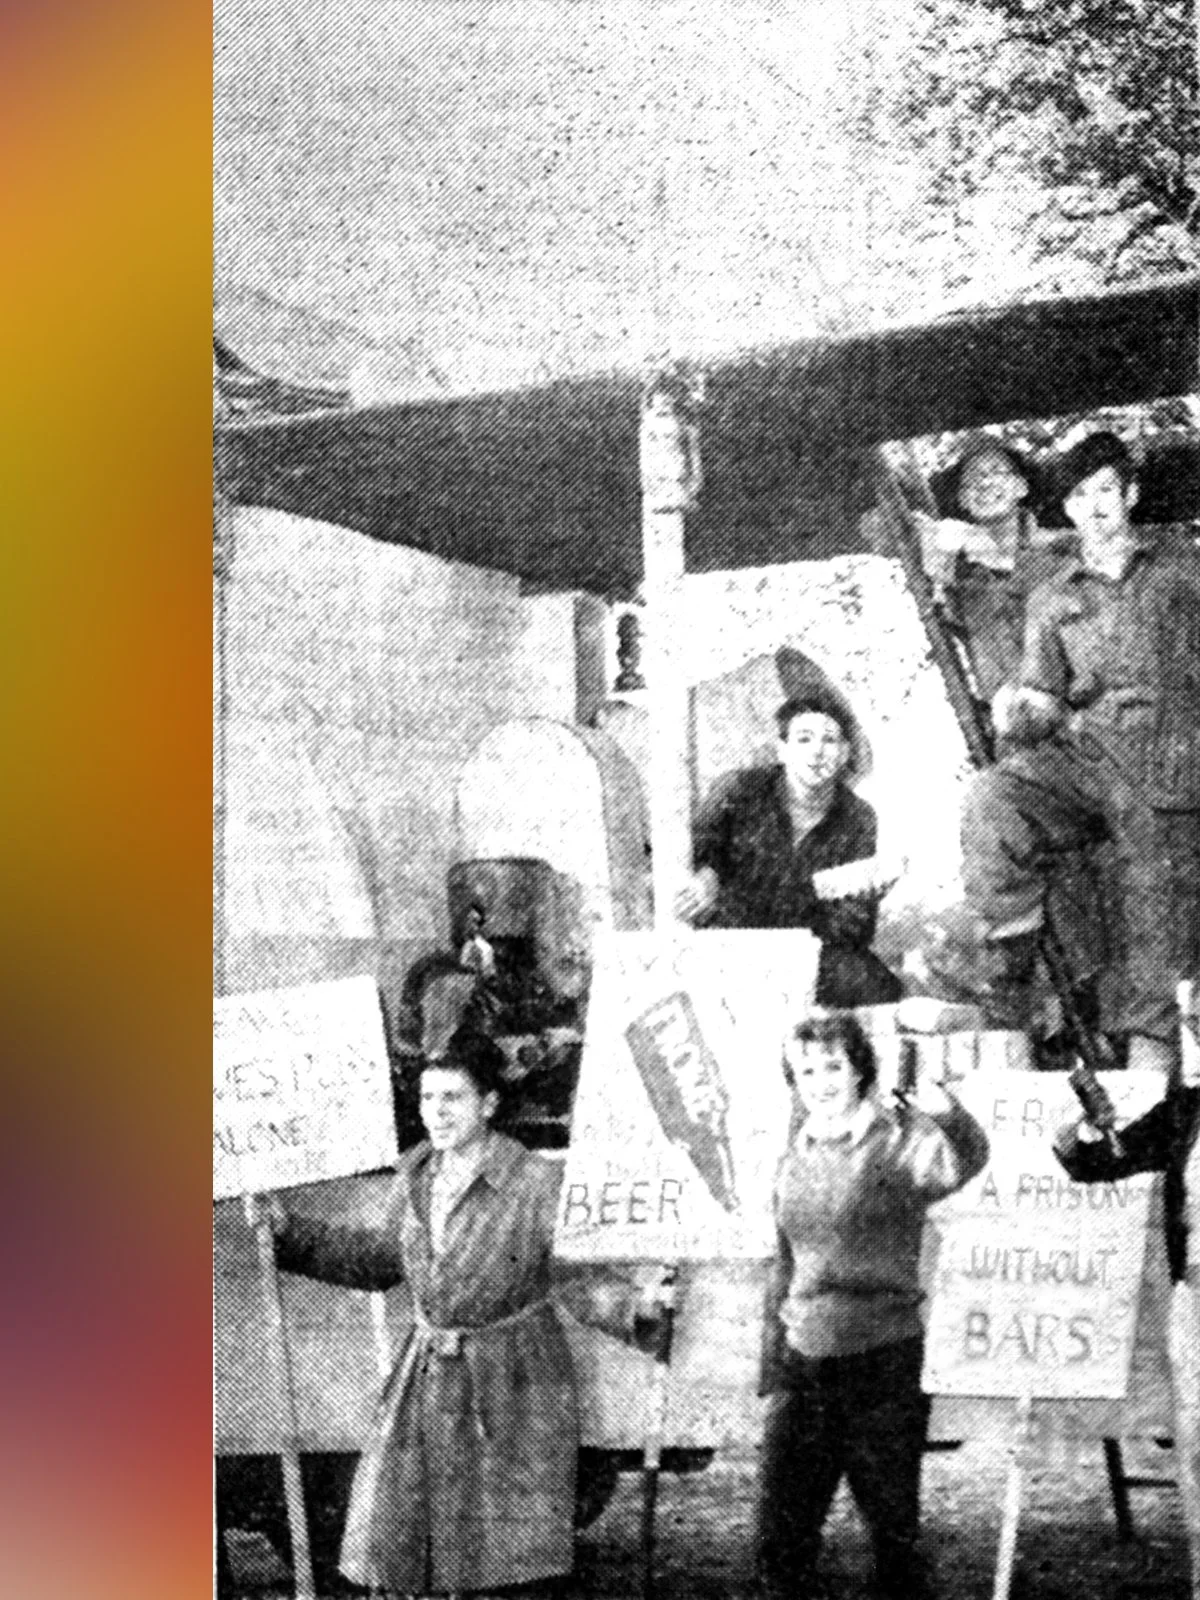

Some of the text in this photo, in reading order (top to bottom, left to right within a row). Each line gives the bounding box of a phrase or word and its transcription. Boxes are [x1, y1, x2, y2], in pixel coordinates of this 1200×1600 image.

[563, 1178, 683, 1227] BEER
[980, 1171, 1129, 1210] A PRISON
[967, 1246, 1119, 1289] WITHOUT
[963, 1311, 1094, 1364] BARS
